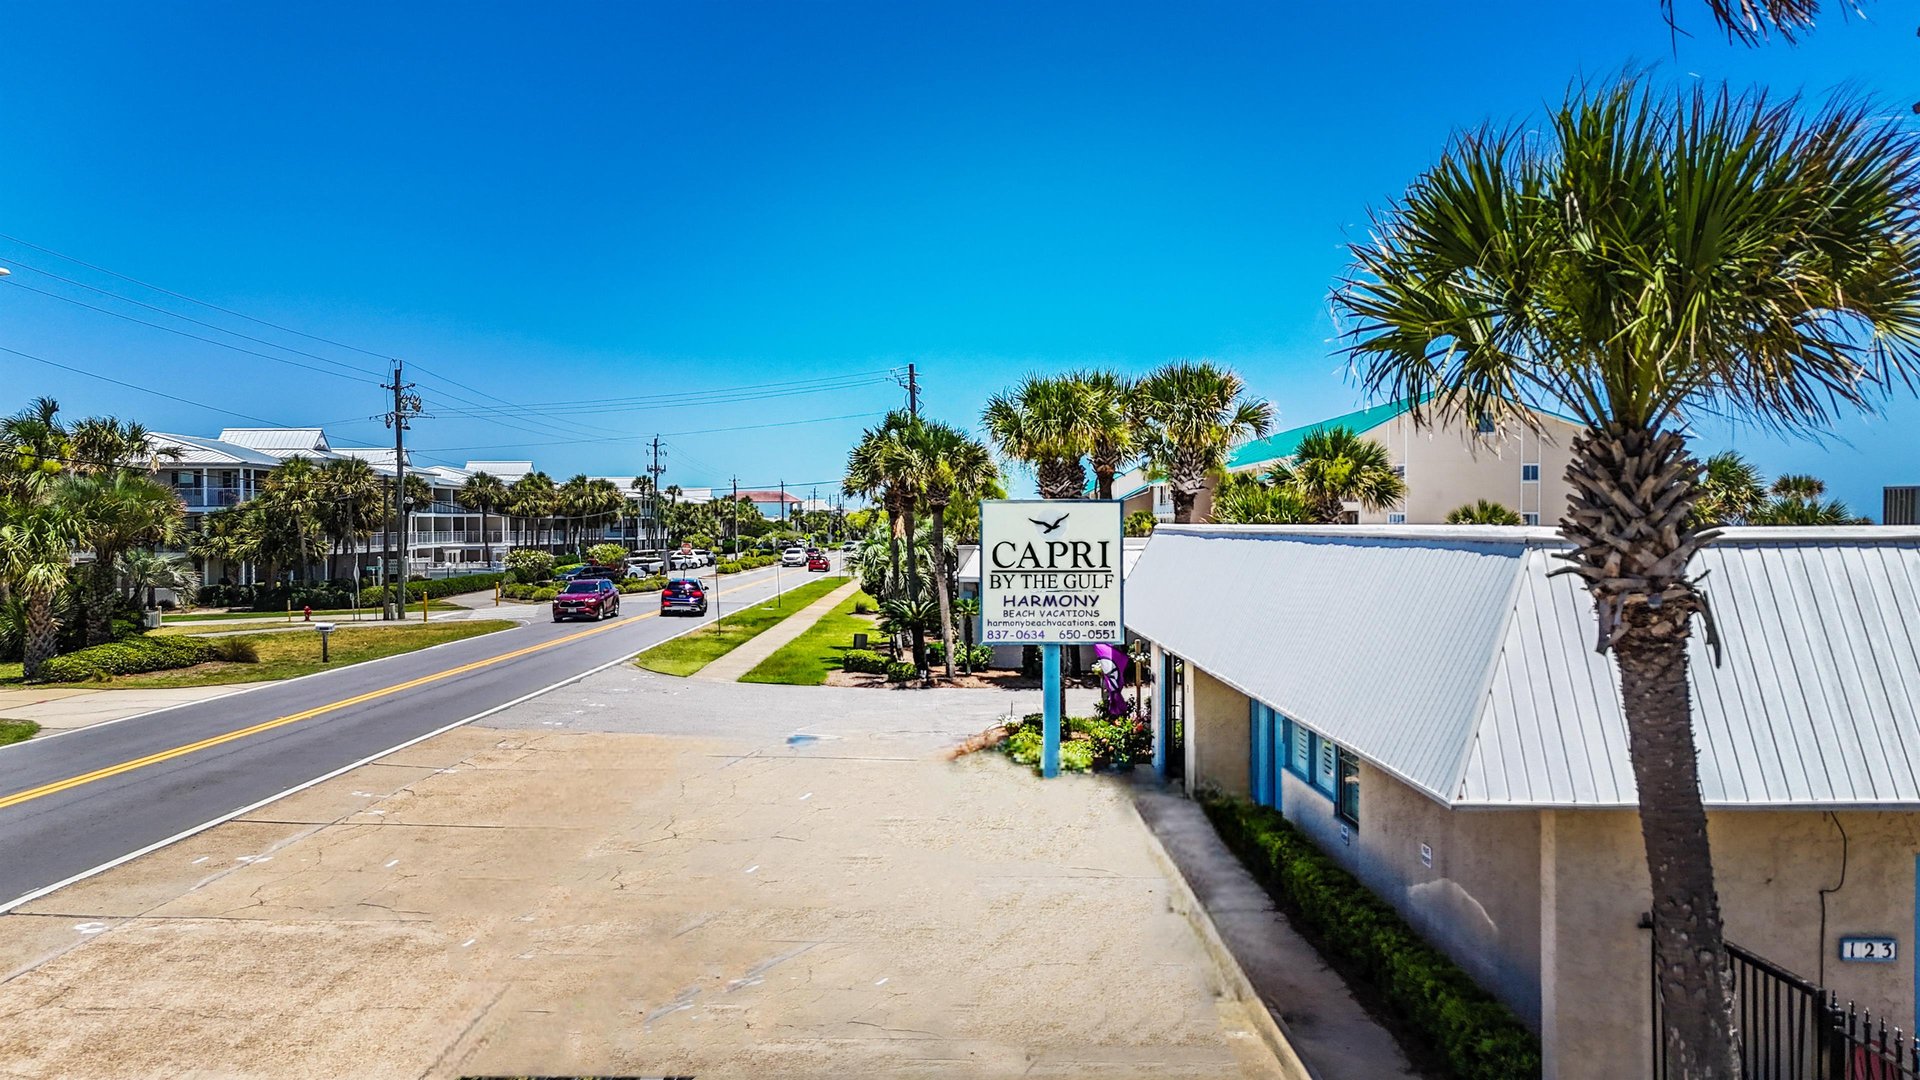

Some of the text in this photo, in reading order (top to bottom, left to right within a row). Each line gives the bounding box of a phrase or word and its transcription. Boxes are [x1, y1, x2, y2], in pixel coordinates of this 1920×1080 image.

[991, 541, 1111, 569] CAPRI
[989, 574, 1114, 589] BY THE GULF
[1003, 595, 1100, 608] HARMONY
[1003, 609, 1100, 618] BEACH VACATIONS
[987, 619, 1116, 629] harmonybeachvacations.com
[986, 630, 1116, 640] 837-0634 650-0551
[1850, 942, 1892, 958] 123
